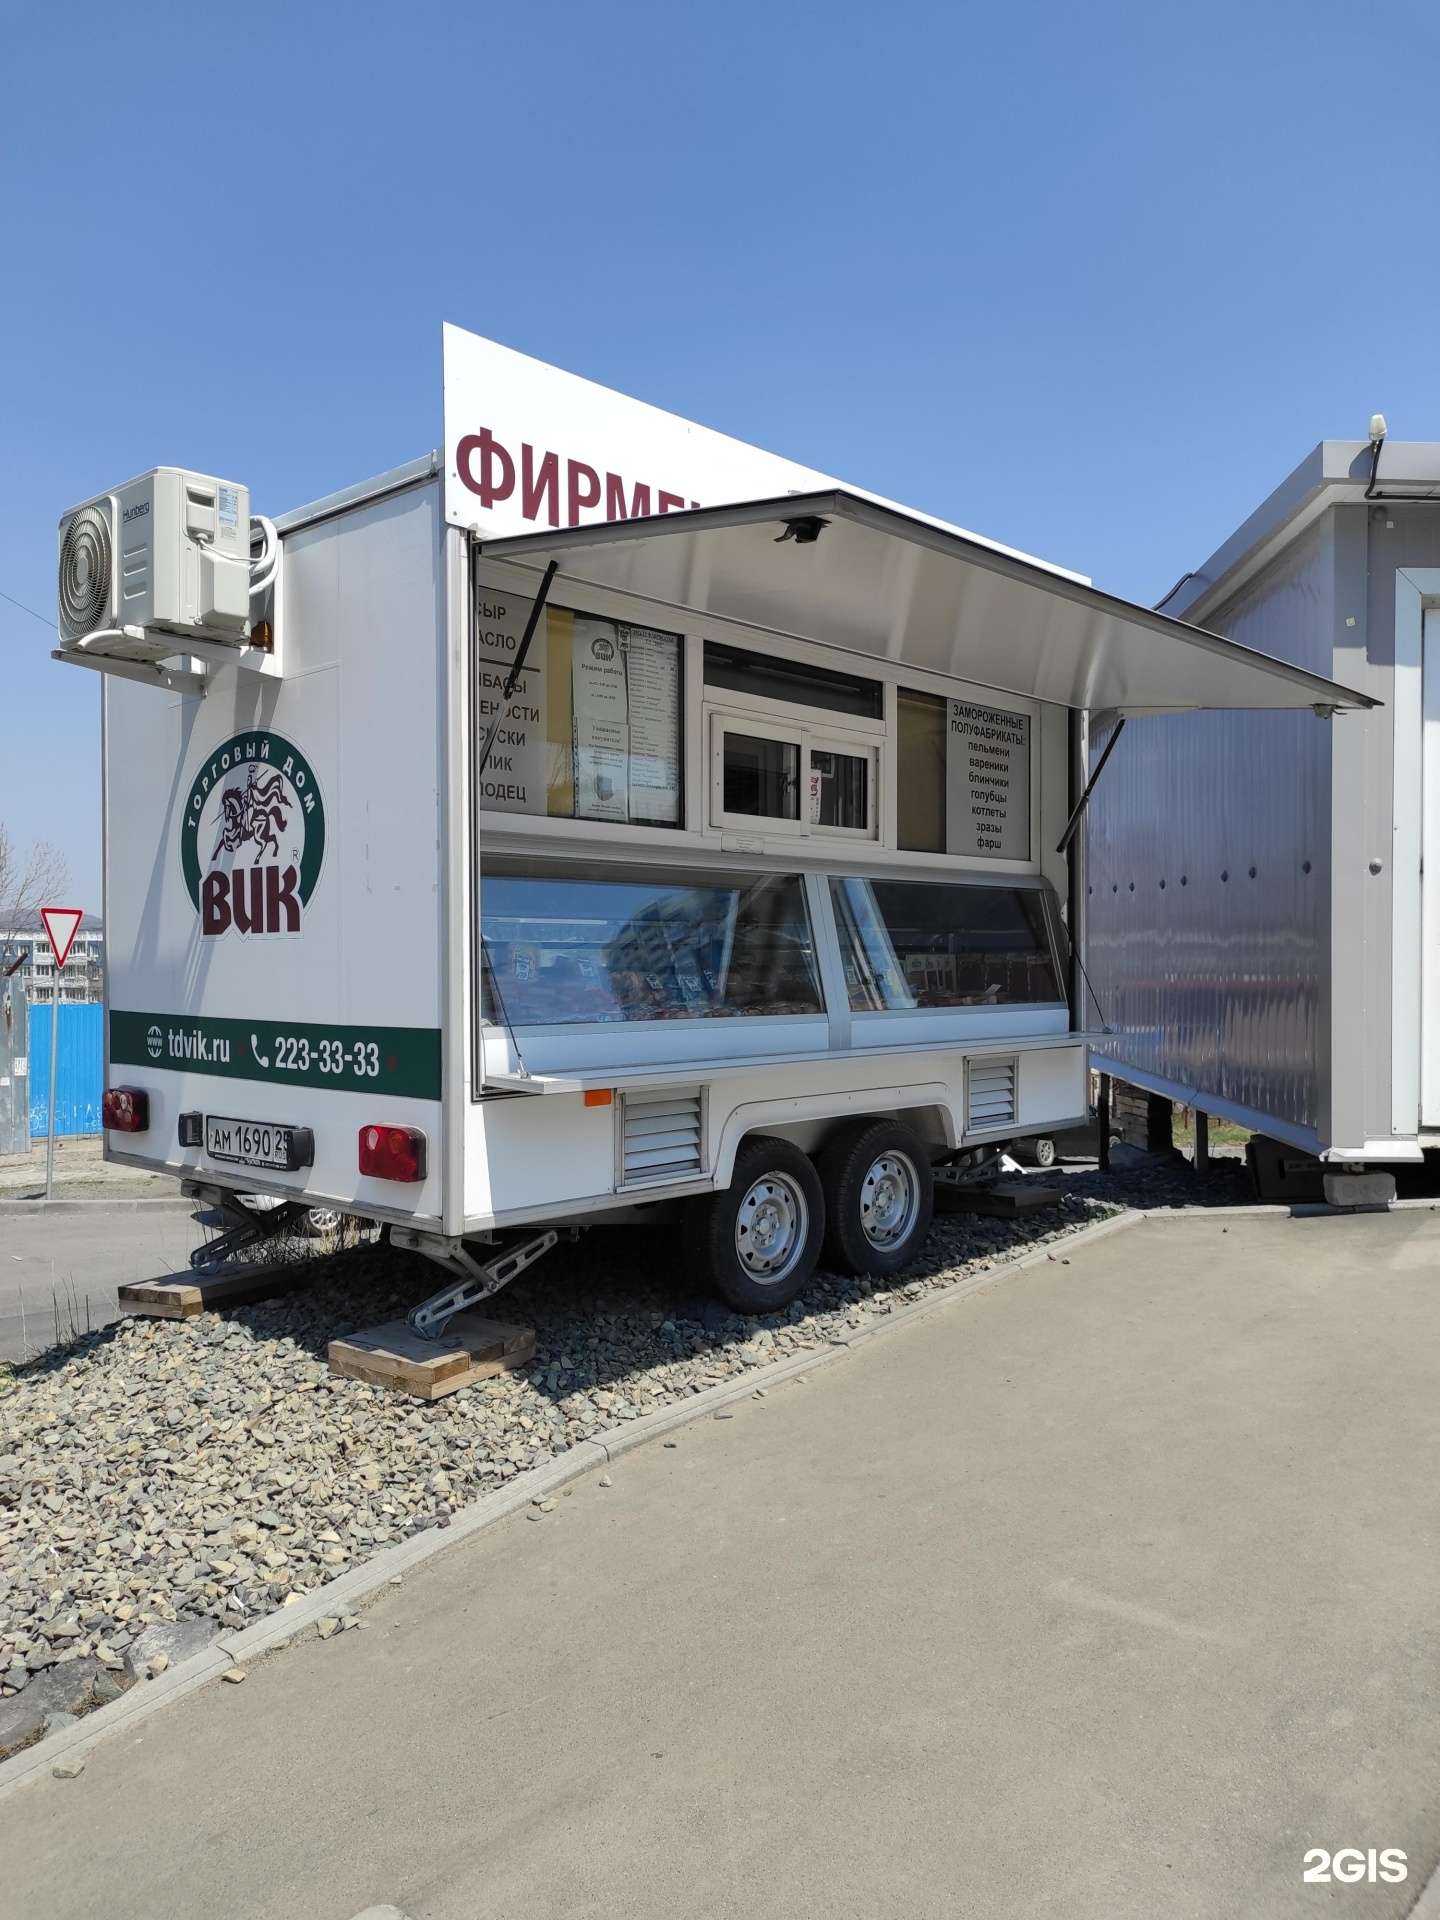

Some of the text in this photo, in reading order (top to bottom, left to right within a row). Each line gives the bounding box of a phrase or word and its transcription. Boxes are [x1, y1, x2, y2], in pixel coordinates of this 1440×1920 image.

[456, 426, 701, 528] ФИРМ
[479, 629, 516, 650] АСЛО
[480, 700, 540, 723] ЕНСТИ
[953, 704, 1024, 730] ЗАМОРОЖЕННЫЕ
[968, 742, 1010, 757] пельмени
[969, 758, 1009, 772] вареники
[187, 739, 316, 832] ТОРГОВЫЙ ДОМ
[968, 772, 1009, 788] блинчики
[971, 790, 1007, 804] голубцы
[971, 806, 1007, 818] котлеты
[976, 823, 1002, 833] зразы
[977, 836, 1002, 851] фарш
[168, 1029, 231, 1063] tdvik.ru
[274, 1036, 380, 1077] 223-33-33
